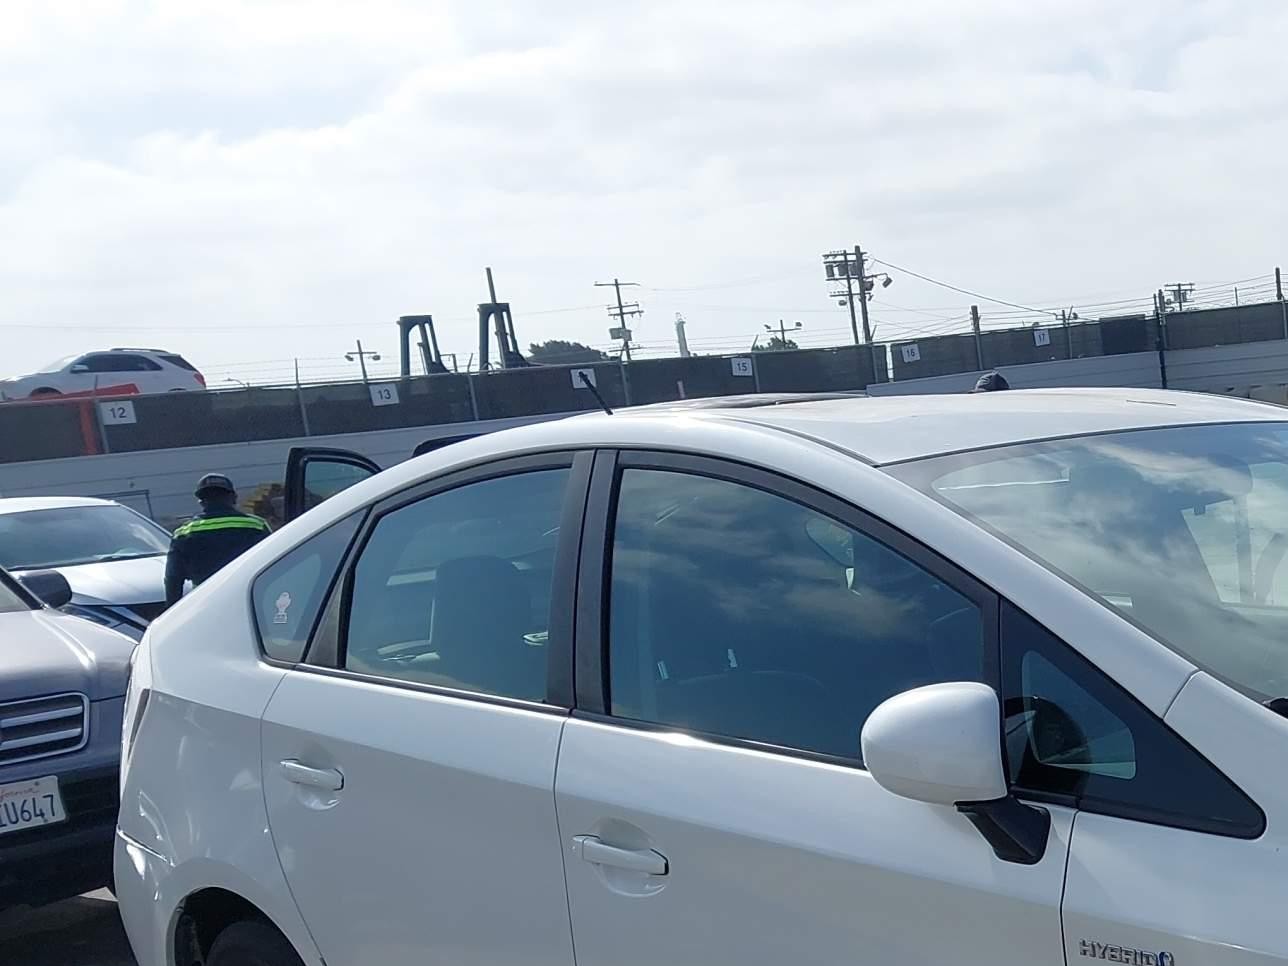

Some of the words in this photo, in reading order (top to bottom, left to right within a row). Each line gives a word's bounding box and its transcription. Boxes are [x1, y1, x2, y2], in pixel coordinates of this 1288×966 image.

[736, 361, 748, 372] 15
[377, 388, 392, 401] 13
[110, 406, 127, 419] 12
